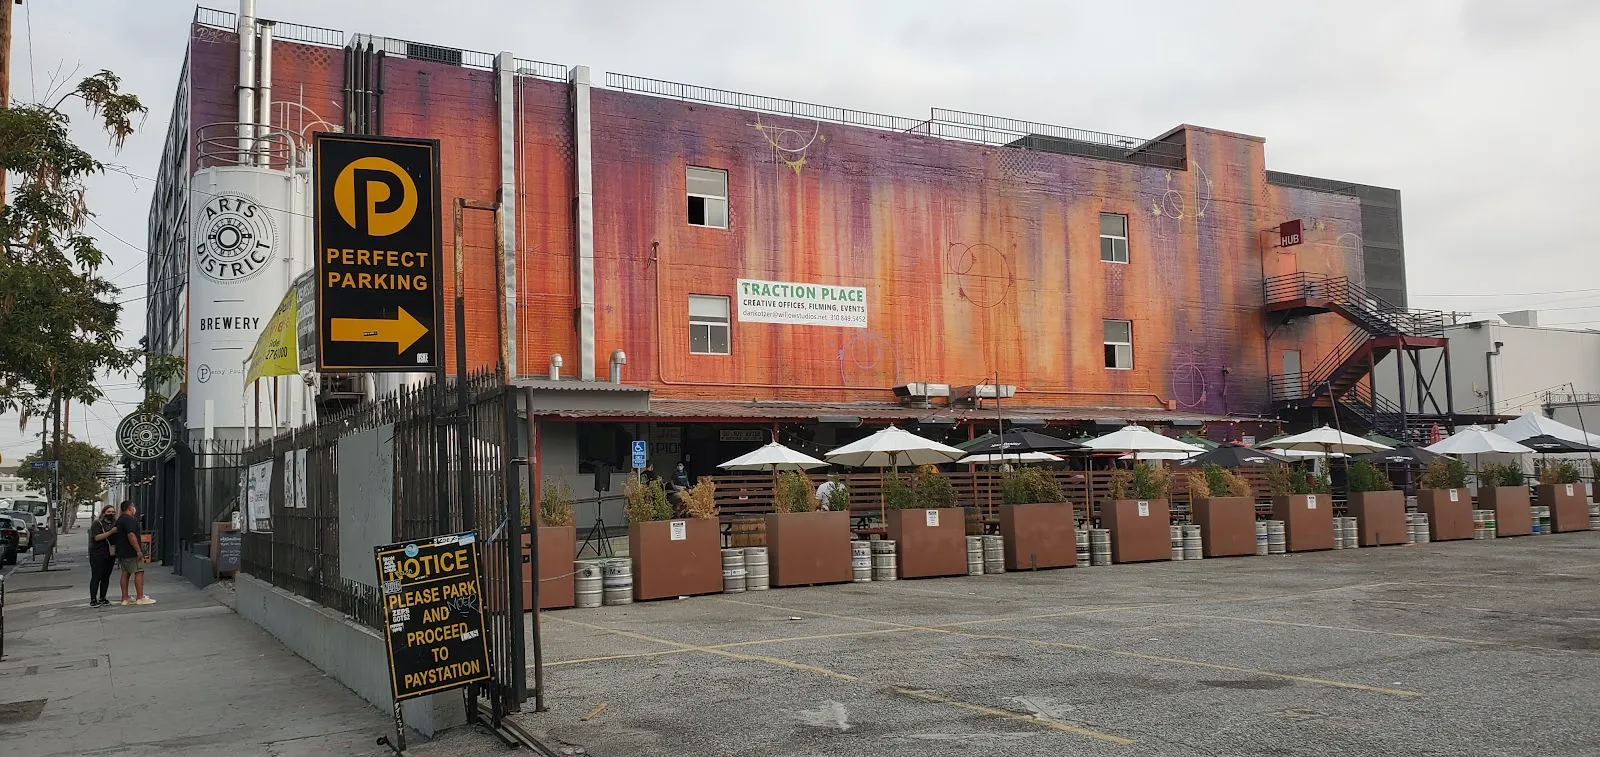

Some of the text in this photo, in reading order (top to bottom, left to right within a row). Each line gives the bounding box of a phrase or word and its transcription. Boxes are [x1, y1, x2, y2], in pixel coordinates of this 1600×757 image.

[206, 198, 257, 220] ARTS
[1281, 234, 1300, 247] HUB
[197, 240, 270, 277] DISTRICT
[327, 248, 428, 268] PERFECT
[328, 272, 428, 291] PARKING
[742, 282, 863, 302] TRACTION PLACE
[743, 299, 865, 313] CREATIVE OFFICES, FILMING, EVENTS
[200, 316, 260, 331] BREWERY
[130, 414, 161, 426] ARTS
[122, 436, 170, 457] DISTRICT
[389, 549, 469, 581] NOTICE
[389, 587, 440, 609] PLEASE
[442, 580, 477, 600] PARK
[422, 606, 450, 624] AND
[407, 622, 468, 647] PROCEED
[431, 646, 449, 662] TO
[405, 659, 480, 689] PAYSTATION
